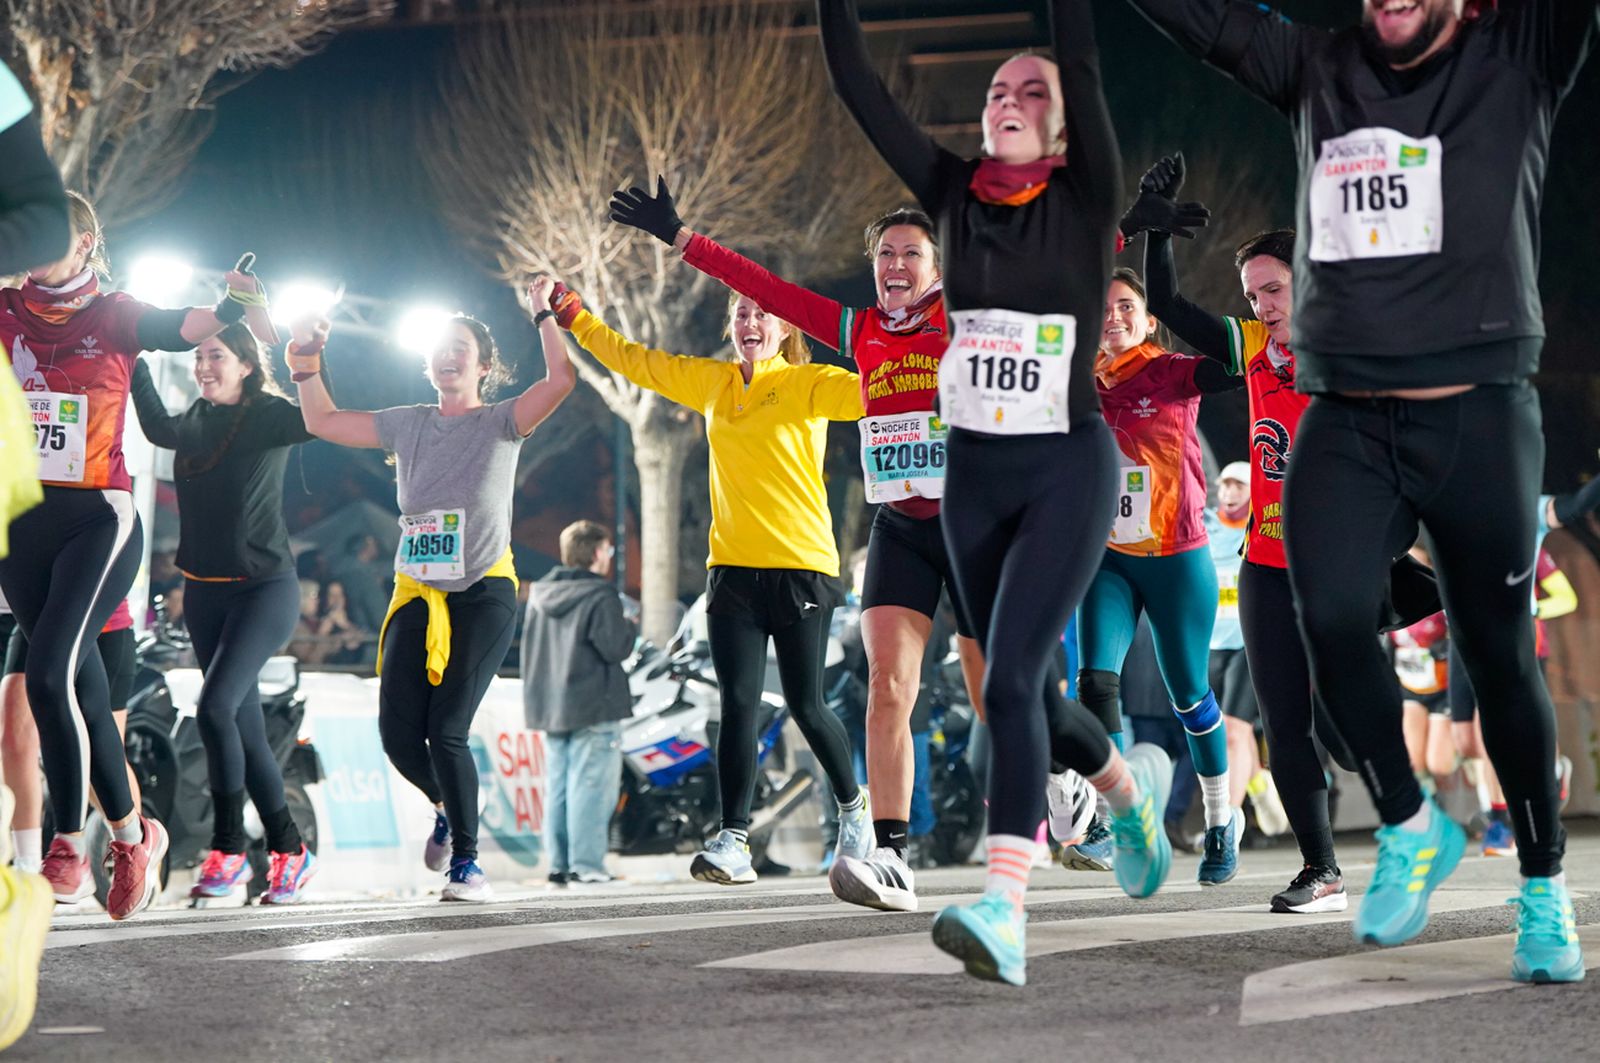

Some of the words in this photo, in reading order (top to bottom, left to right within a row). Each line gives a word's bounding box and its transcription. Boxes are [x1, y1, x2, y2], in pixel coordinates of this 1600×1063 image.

[1339, 174, 1408, 214] 1185
[967, 354, 1041, 392] 1186
[871, 436, 890, 446] SAN
[881, 422, 909, 433] NOCHE
[910, 421, 921, 431] DE
[871, 441, 946, 472] 12096
